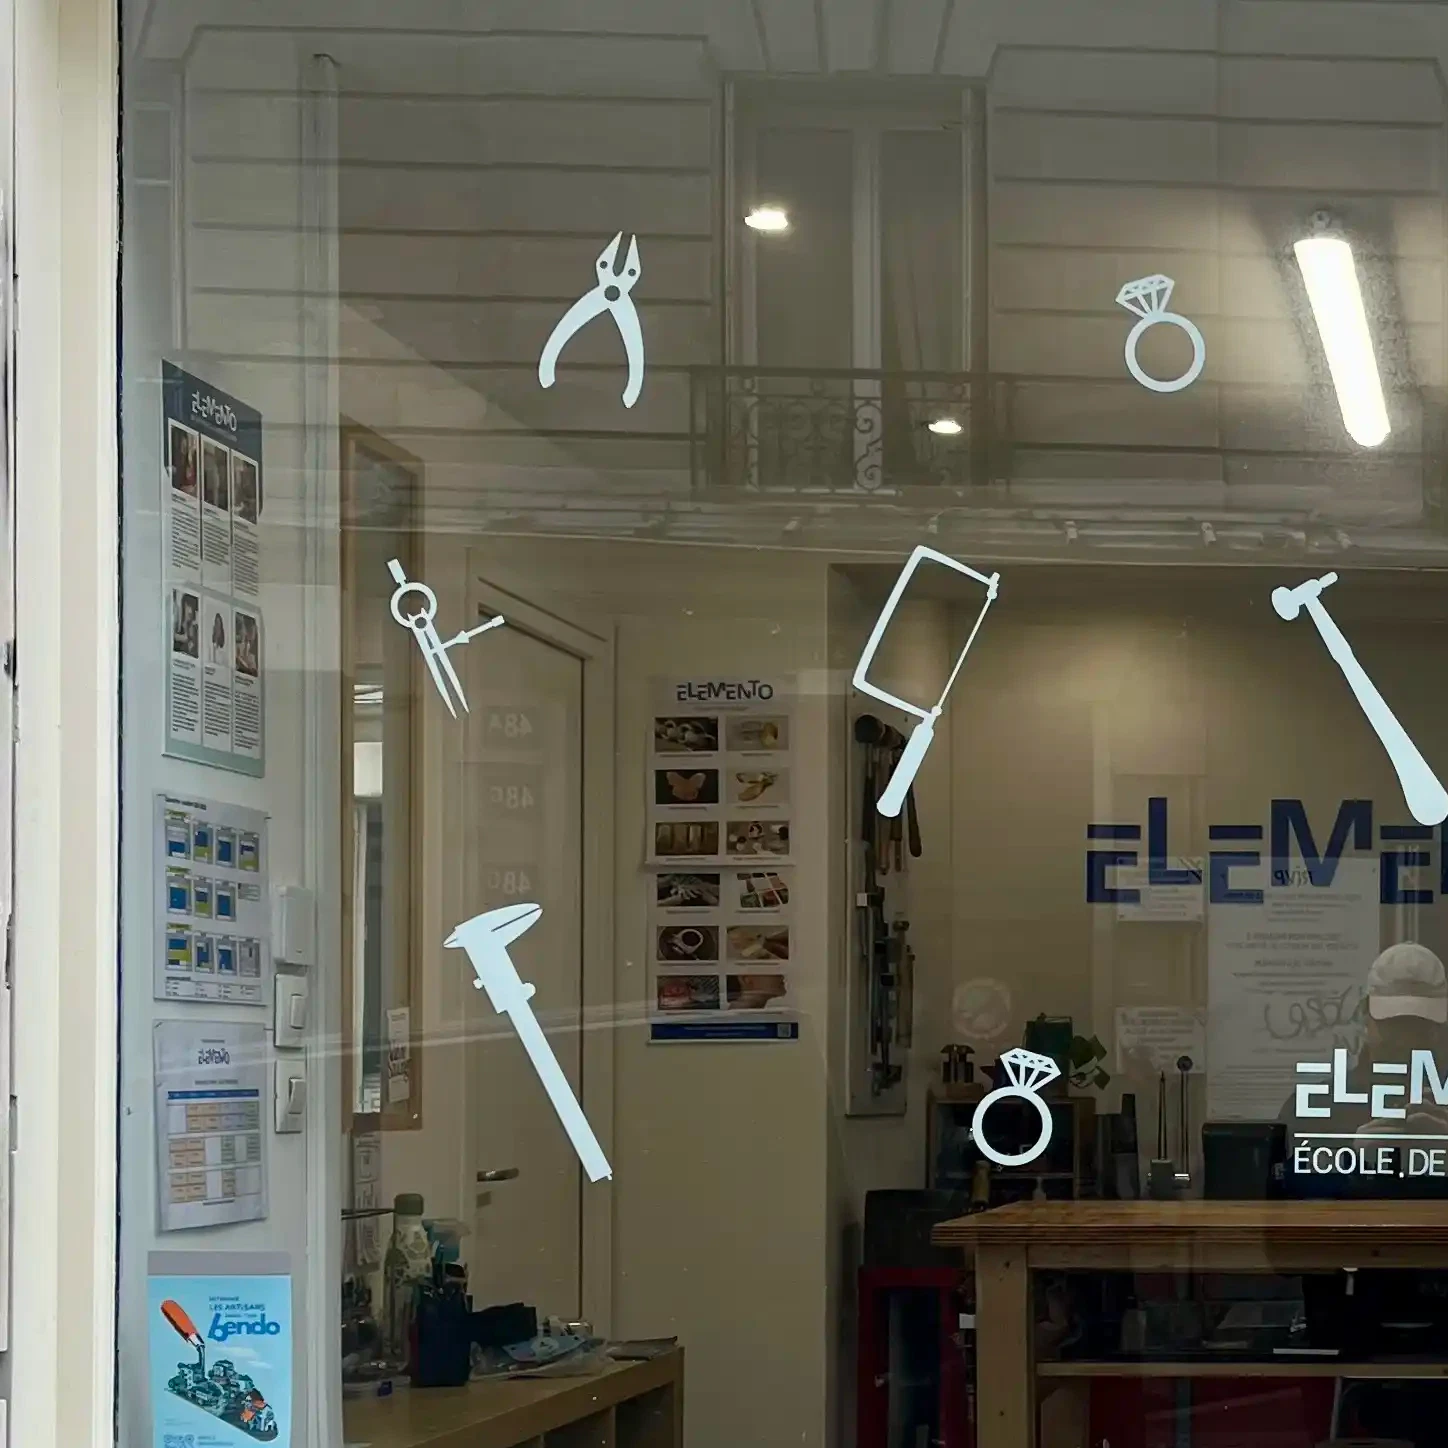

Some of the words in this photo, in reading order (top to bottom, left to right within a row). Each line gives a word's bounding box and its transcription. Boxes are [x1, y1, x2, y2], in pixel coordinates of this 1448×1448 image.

[676, 680, 774, 701] ELEMENTO
[1294, 1140, 1395, 1175] ÉCOLE
[1408, 1148, 1447, 1177] DE
[208, 1312, 281, 1342] bendo
